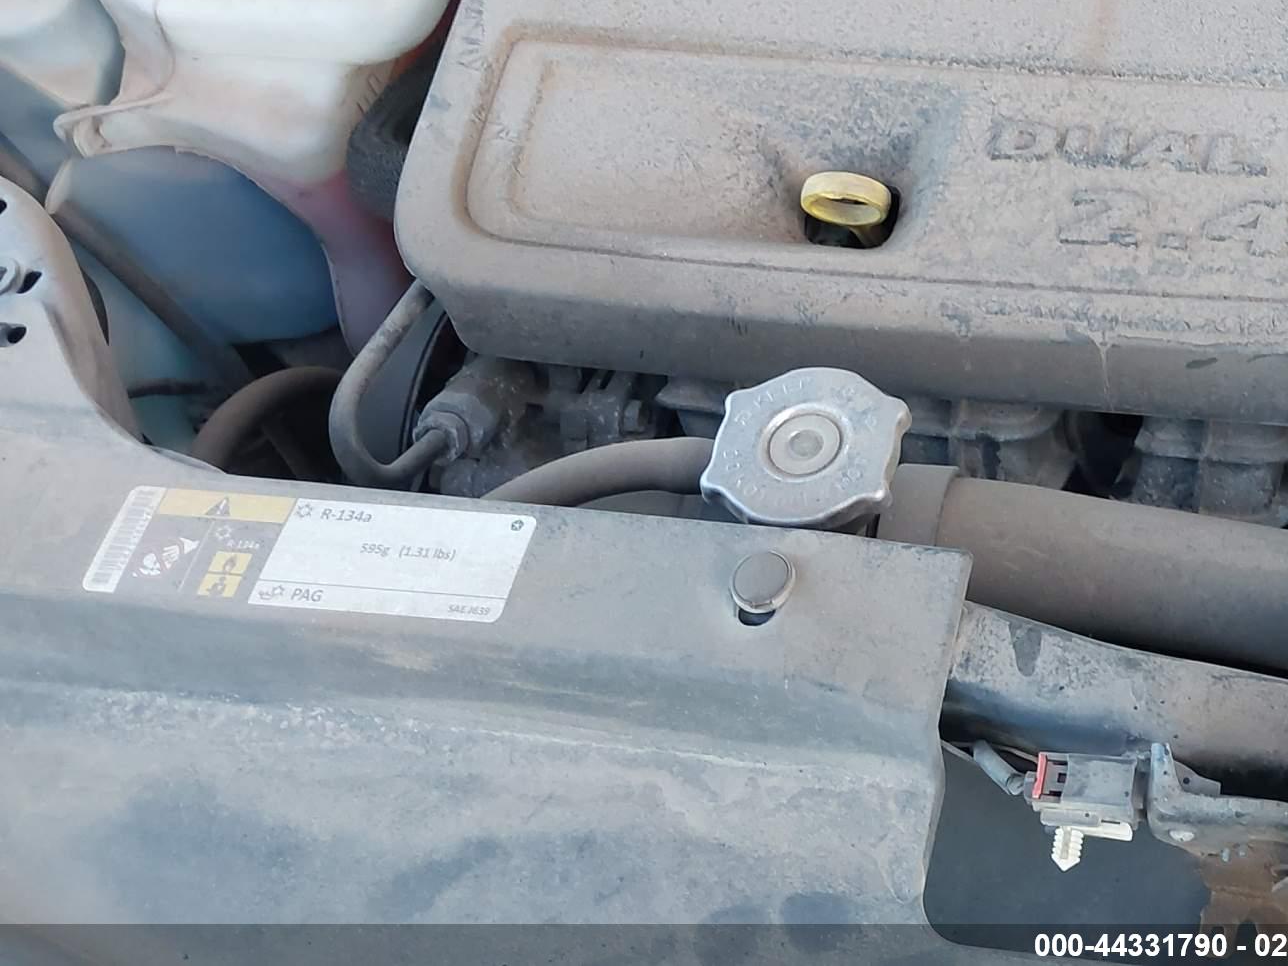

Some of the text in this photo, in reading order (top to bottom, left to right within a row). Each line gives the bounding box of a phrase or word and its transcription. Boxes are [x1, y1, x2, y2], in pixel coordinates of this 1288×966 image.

[986, 114, 1268, 176] DUAL
[320, 507, 373, 523] R-134a
[359, 542, 457, 562] 595g (1.31 lbs)
[290, 586, 323, 603] PAG
[447, 603, 466, 615] SAE
